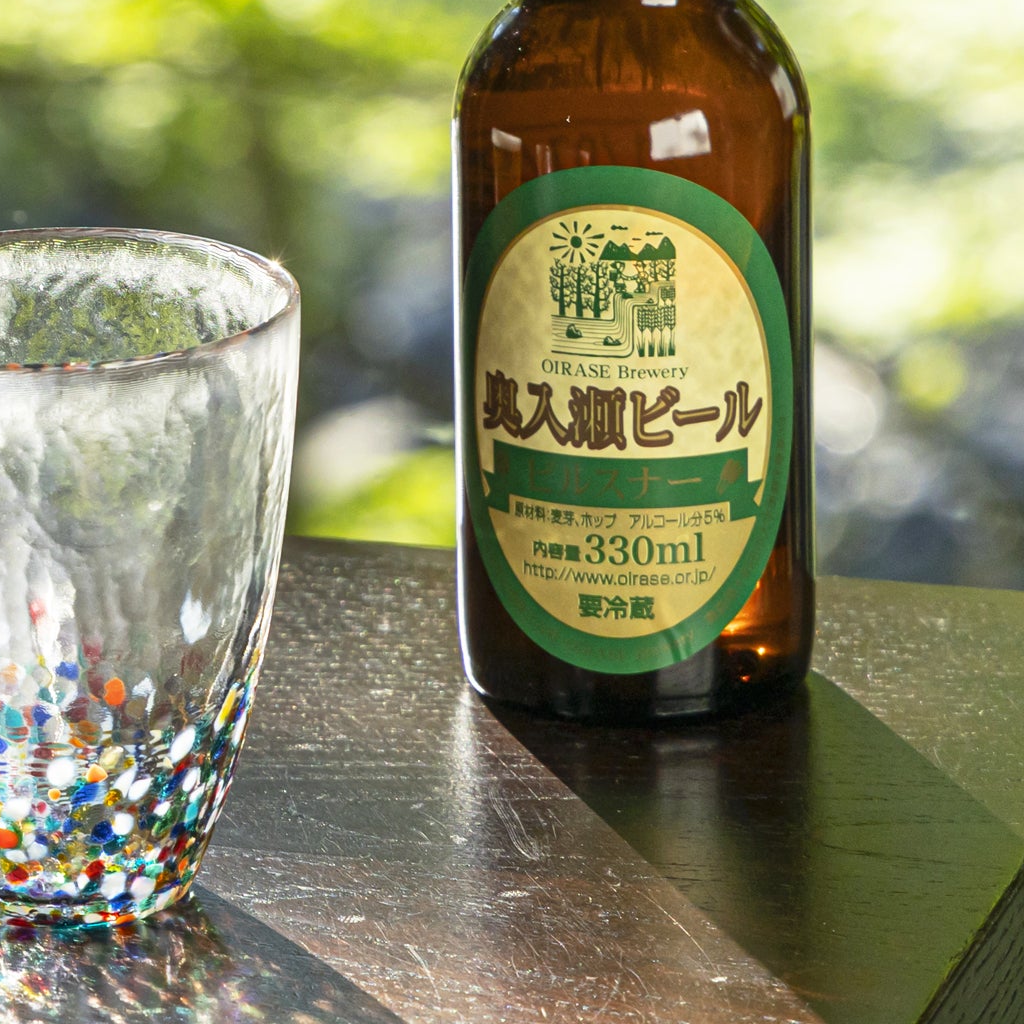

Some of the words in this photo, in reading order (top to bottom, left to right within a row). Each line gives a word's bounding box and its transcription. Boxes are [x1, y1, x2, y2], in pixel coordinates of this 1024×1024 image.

[541, 358, 611, 379] OIRASE
[618, 364, 689, 380] Brewery
[483, 369, 763, 451] 奥入瀬ビール
[533, 540, 581, 562] 内容量
[584, 532, 705, 566] 330ml
[523, 560, 717, 587] http://www.oirase.or.jp/
[578, 593, 656, 621] 要冷蔵
